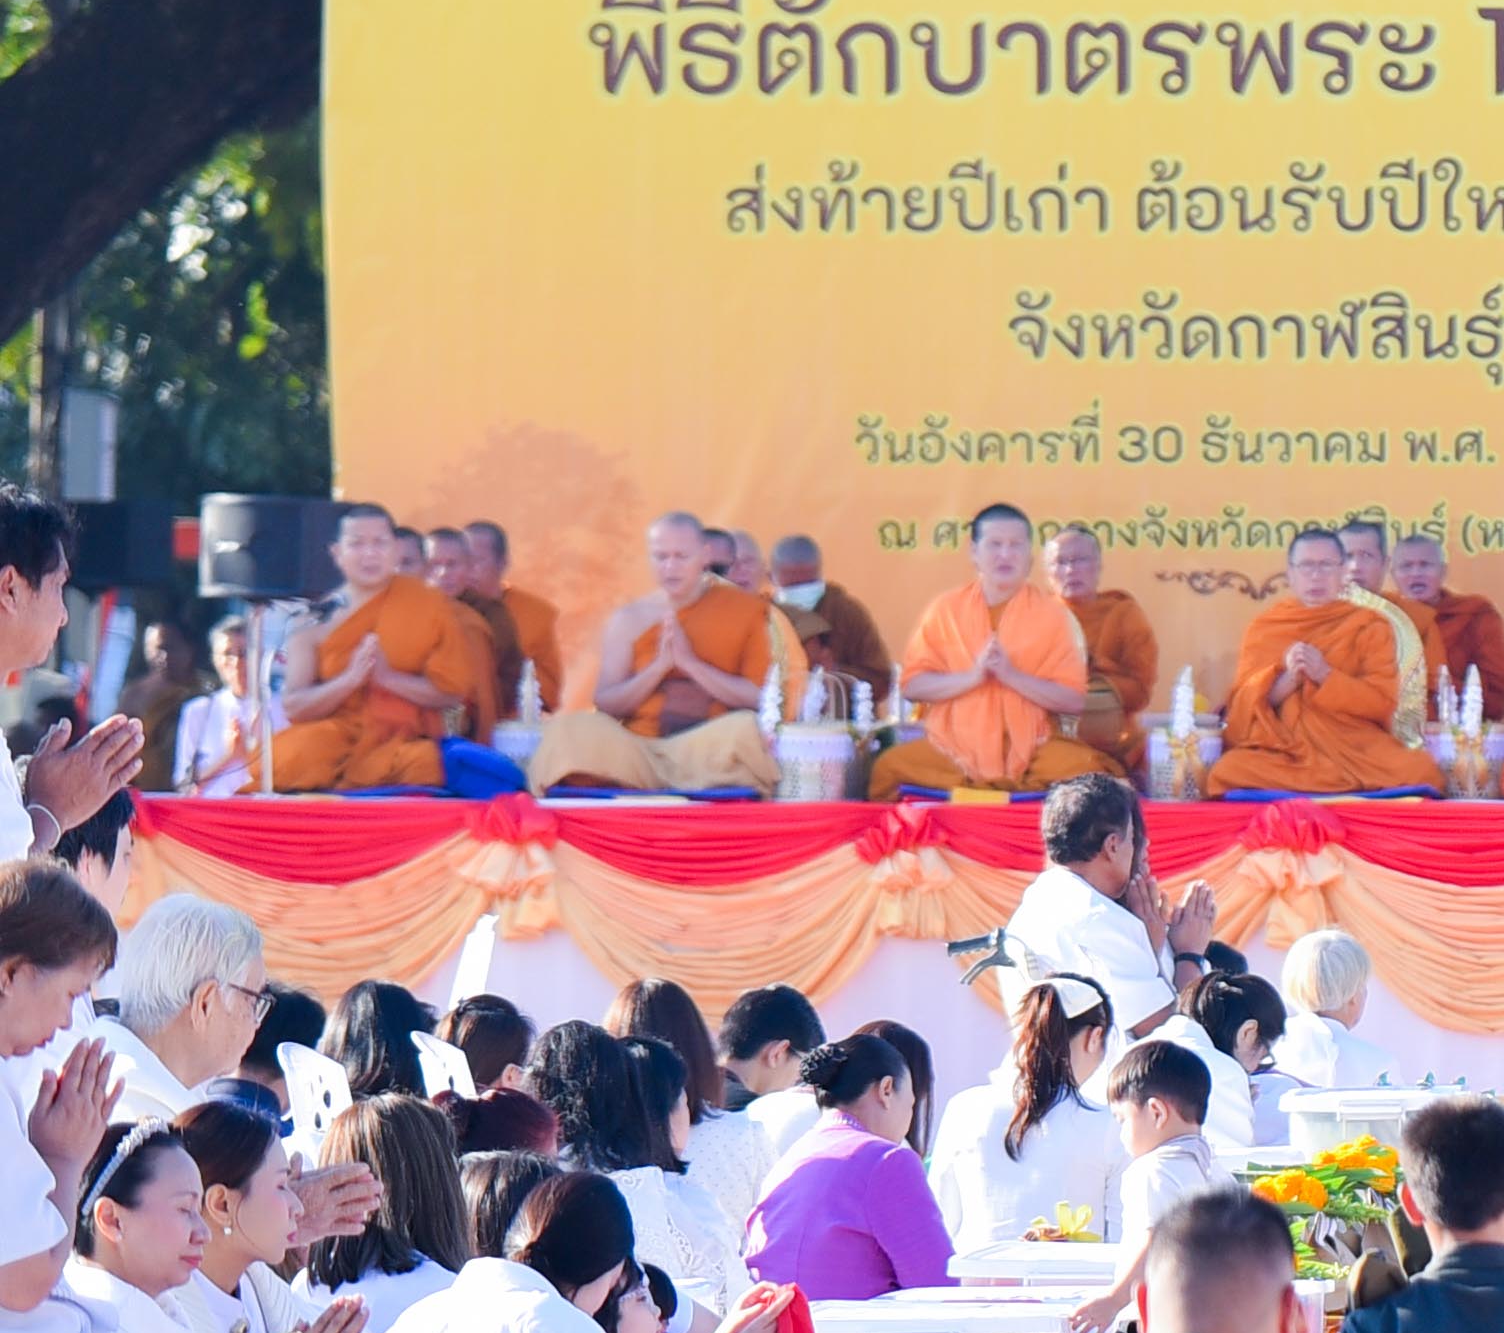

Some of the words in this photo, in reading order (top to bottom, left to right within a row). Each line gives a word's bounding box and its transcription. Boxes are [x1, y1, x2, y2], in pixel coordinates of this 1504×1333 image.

[726, 159, 1107, 233] ส่งท้ายปีเก่า
[1008, 284, 1504, 386] จังหวัดกาฬสินธุ์
[855, 400, 1100, 464] วันอังคารที่
[1118, 425, 1182, 463] 30
[1201, 414, 1387, 463] ธันวาคม
[1404, 429, 1496, 463] พ.ศ.
[878, 520, 916, 548] ณ
